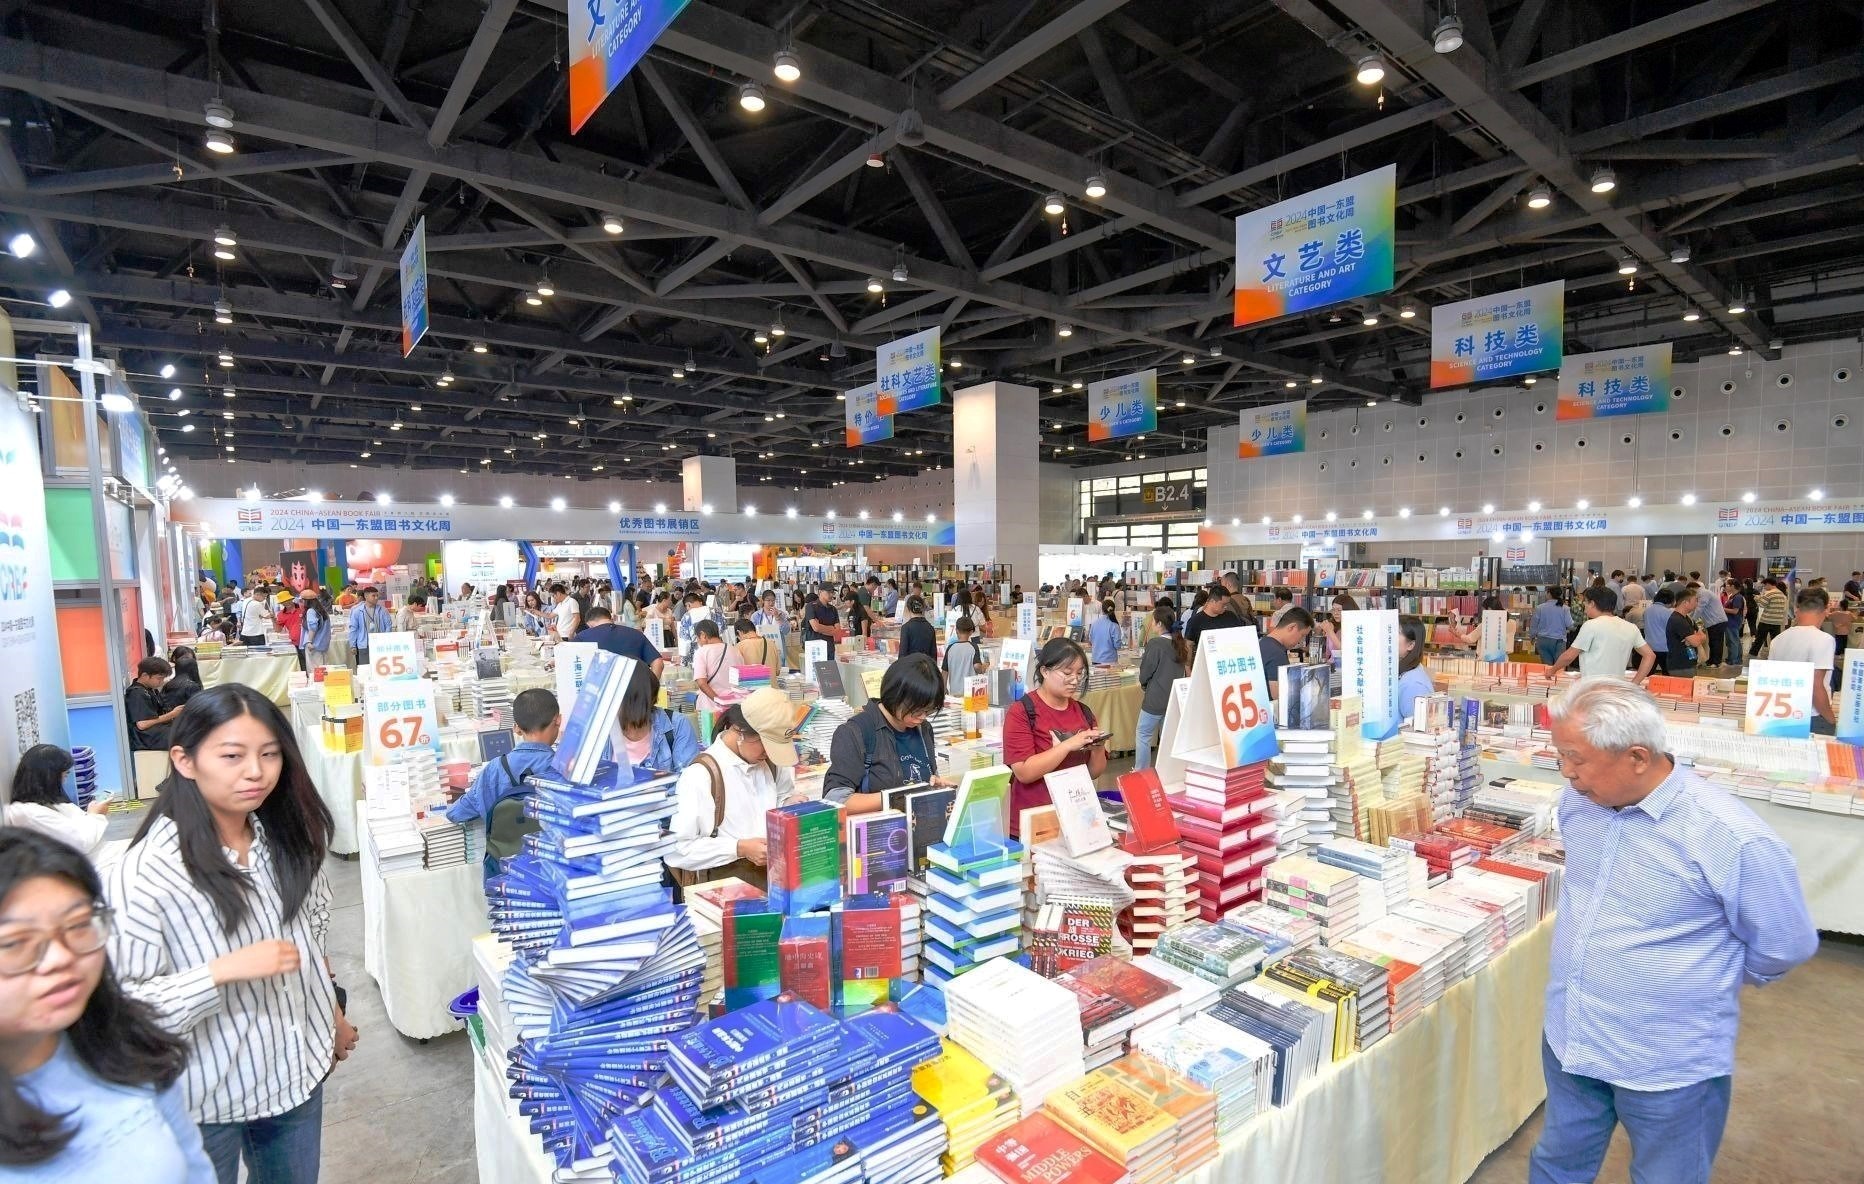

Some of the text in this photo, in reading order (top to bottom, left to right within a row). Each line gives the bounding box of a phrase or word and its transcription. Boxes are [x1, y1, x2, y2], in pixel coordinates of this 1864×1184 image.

[608, 5, 643, 58] CATEGORY
[1285, 209, 1307, 227] 2024
[1307, 207, 1355, 230] 图书文化周
[1262, 229, 1364, 283] 文艺类
[1267, 262, 1356, 293] LITERATURE AND ART
[1288, 279, 1332, 297] CATEGORY
[1492, 308, 1531, 321] 图书文化周
[1455, 324, 1539, 357] 科技类
[1449, 347, 1543, 369] SCIENCE AND TECHNOLOGY
[1477, 360, 1512, 372] CATEGORY
[880, 362, 936, 392] 社科文艺类
[1578, 375, 1650, 397] 科技类
[1597, 402, 1628, 410] CATEGORY
[1613, 394, 1653, 403] TECHNOLOGY
[1100, 400, 1144, 421] 少儿类
[1251, 424, 1294, 442] 少儿类
[1155, 484, 1190, 502] B2.4
[271, 518, 304, 531] 2024
[619, 517, 700, 530] 优秀图书展销区
[1745, 515, 1775, 526] 2024
[375, 655, 406, 676] 6.5
[574, 655, 583, 694] 上海三联
[1217, 656, 1256, 675] 部分图书
[1356, 624, 1365, 718] 社会科学文献出
[377, 699, 426, 712] 部分图书
[1221, 680, 1259, 732] 6.5
[1754, 691, 1793, 718] 7.5
[379, 716, 423, 749] 6.7
[1067, 917, 1090, 928] DER
[1058, 949, 1095, 959] KRIEG
[1021, 1148, 1071, 1183] MIDDLE
[1042, 1145, 1093, 1181] POWERS
